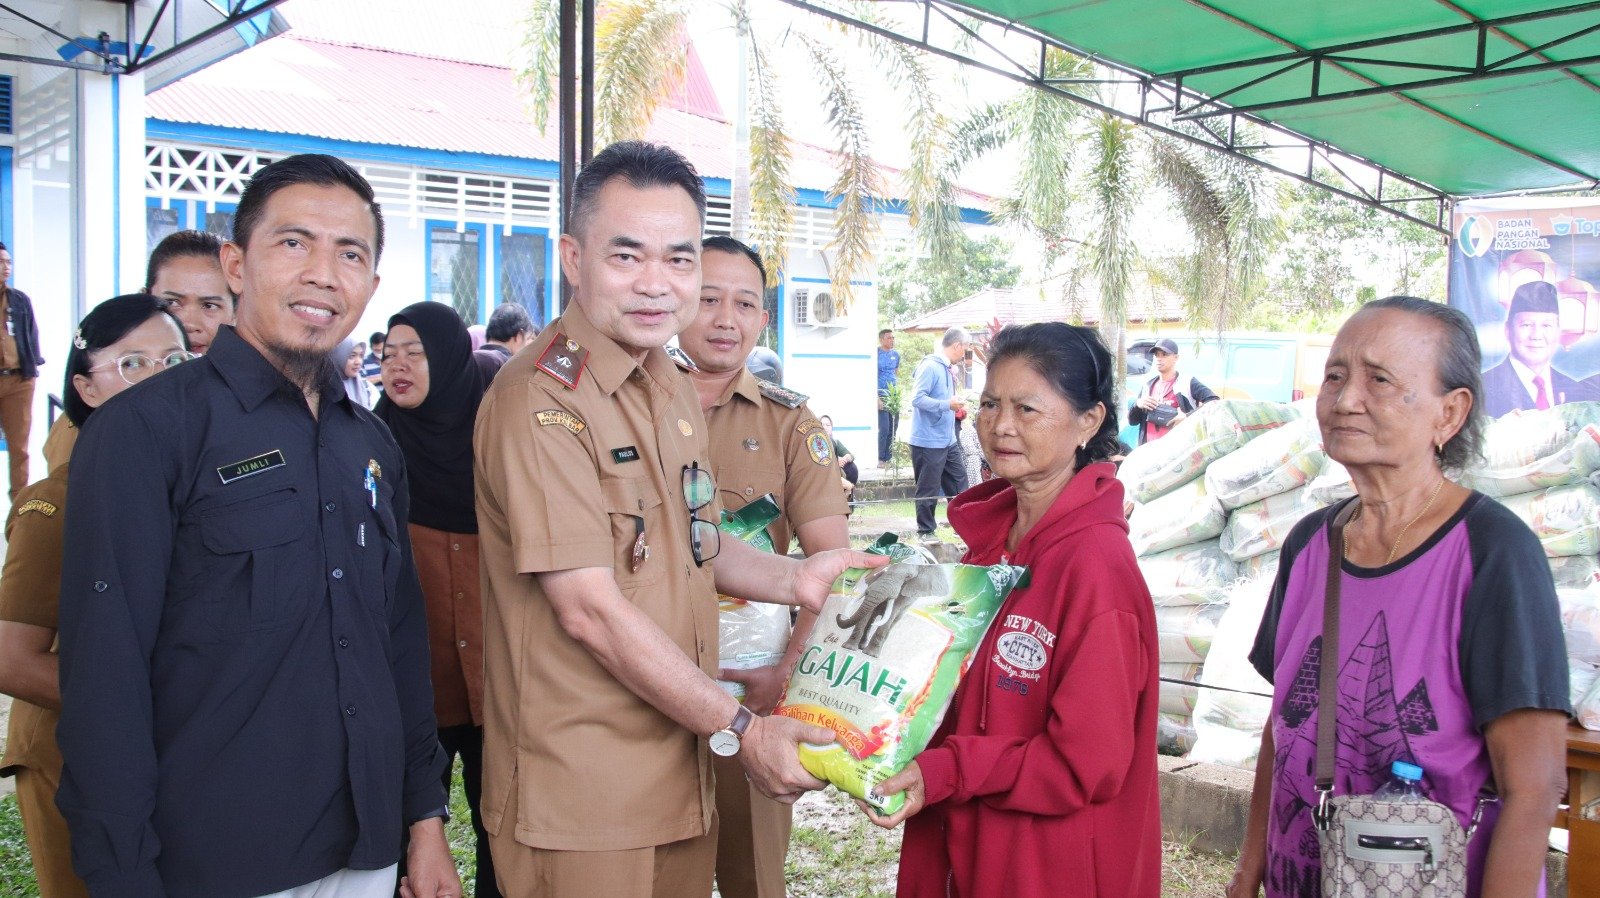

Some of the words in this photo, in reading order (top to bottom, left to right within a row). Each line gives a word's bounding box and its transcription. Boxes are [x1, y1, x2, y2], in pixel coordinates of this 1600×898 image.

[1497, 219, 1531, 229] BADAN
[1497, 229, 1539, 239] PANGAN
[1496, 240, 1549, 249] NASIONAL
[236, 459, 270, 475] JUMLI
[1003, 614, 1033, 632] NEW
[1031, 621, 1057, 648] YORK
[1009, 640, 1037, 662] CITY
[798, 645, 908, 706] GAJAH
[798, 688, 817, 700] BEST
[819, 694, 862, 715] QUALITY
[817, 713, 865, 751] Keluarga
